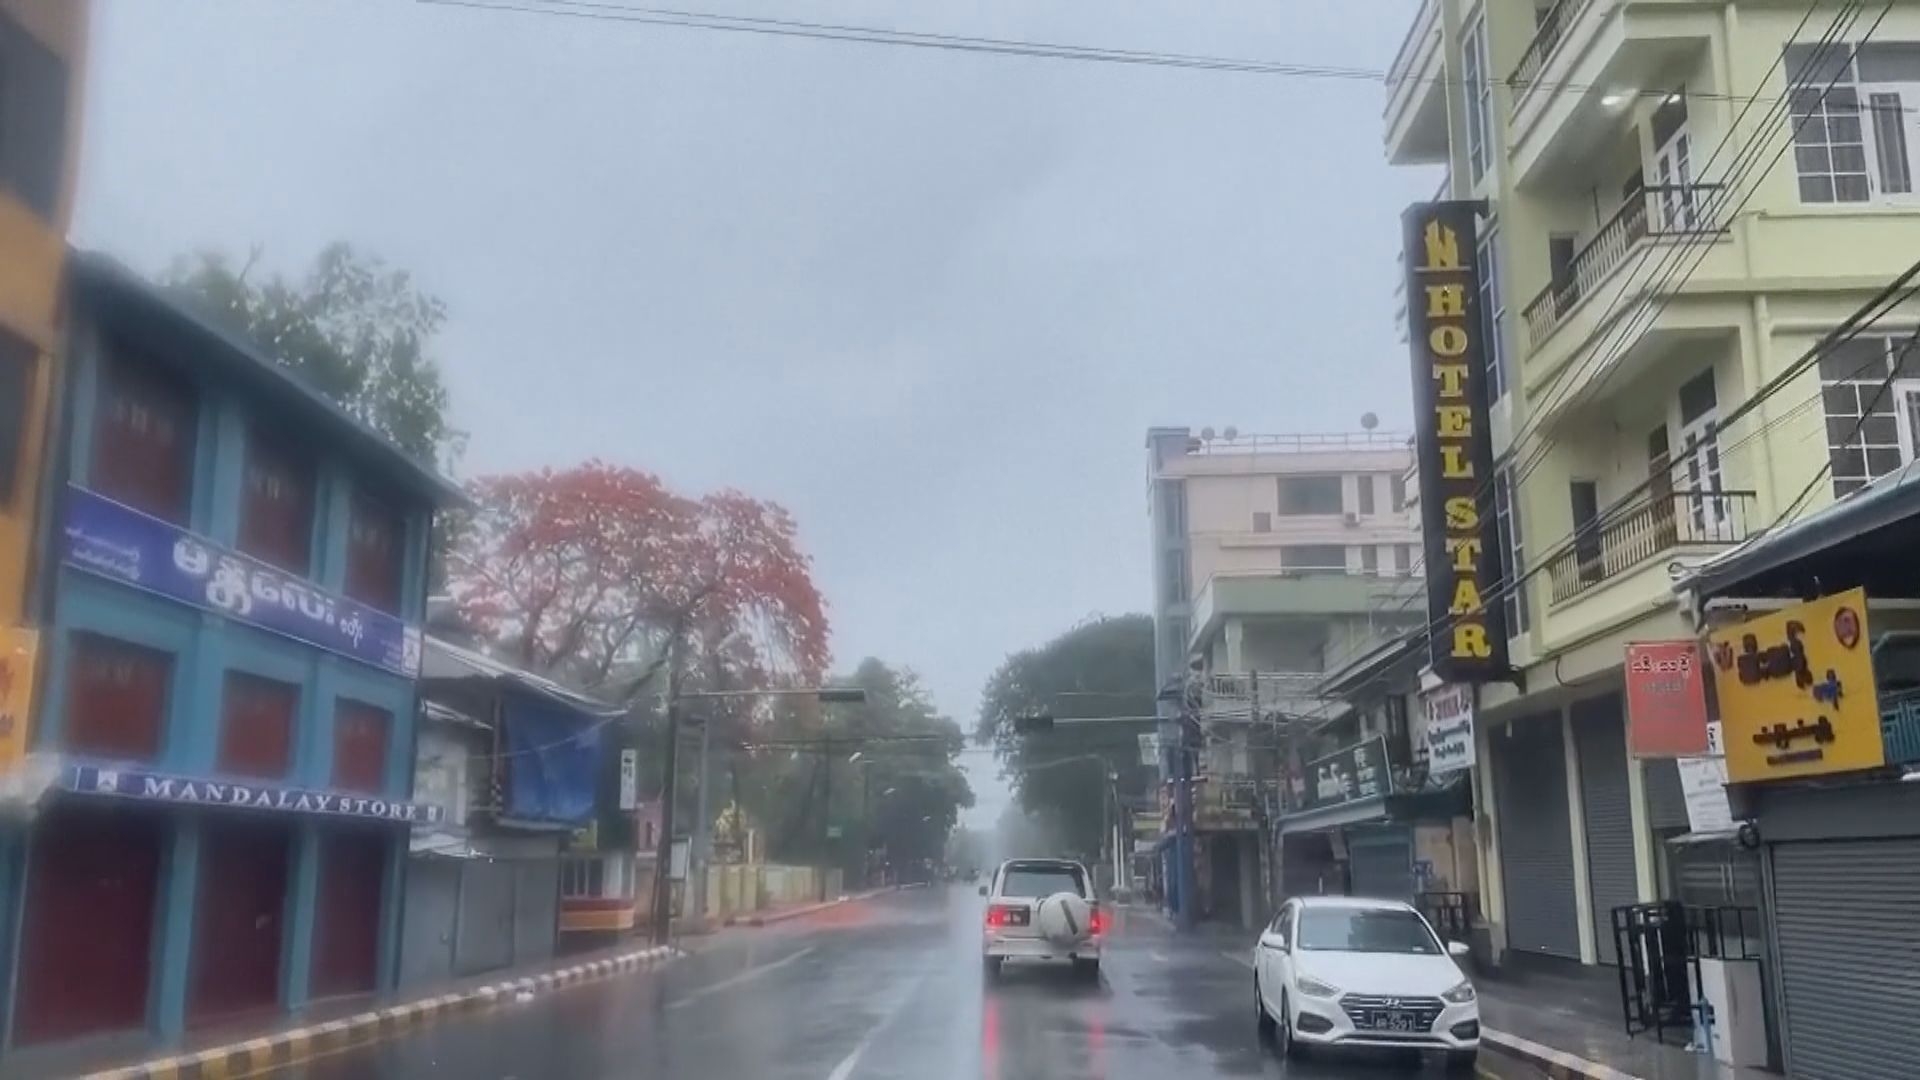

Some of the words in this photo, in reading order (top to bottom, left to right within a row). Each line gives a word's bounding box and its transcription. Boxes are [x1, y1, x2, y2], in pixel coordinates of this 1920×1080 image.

[1426, 284, 1474, 479] HOTEL
[1445, 497, 1492, 657] STAR
[144, 777, 330, 810] MANDALAY
[339, 798, 416, 821] STORE
